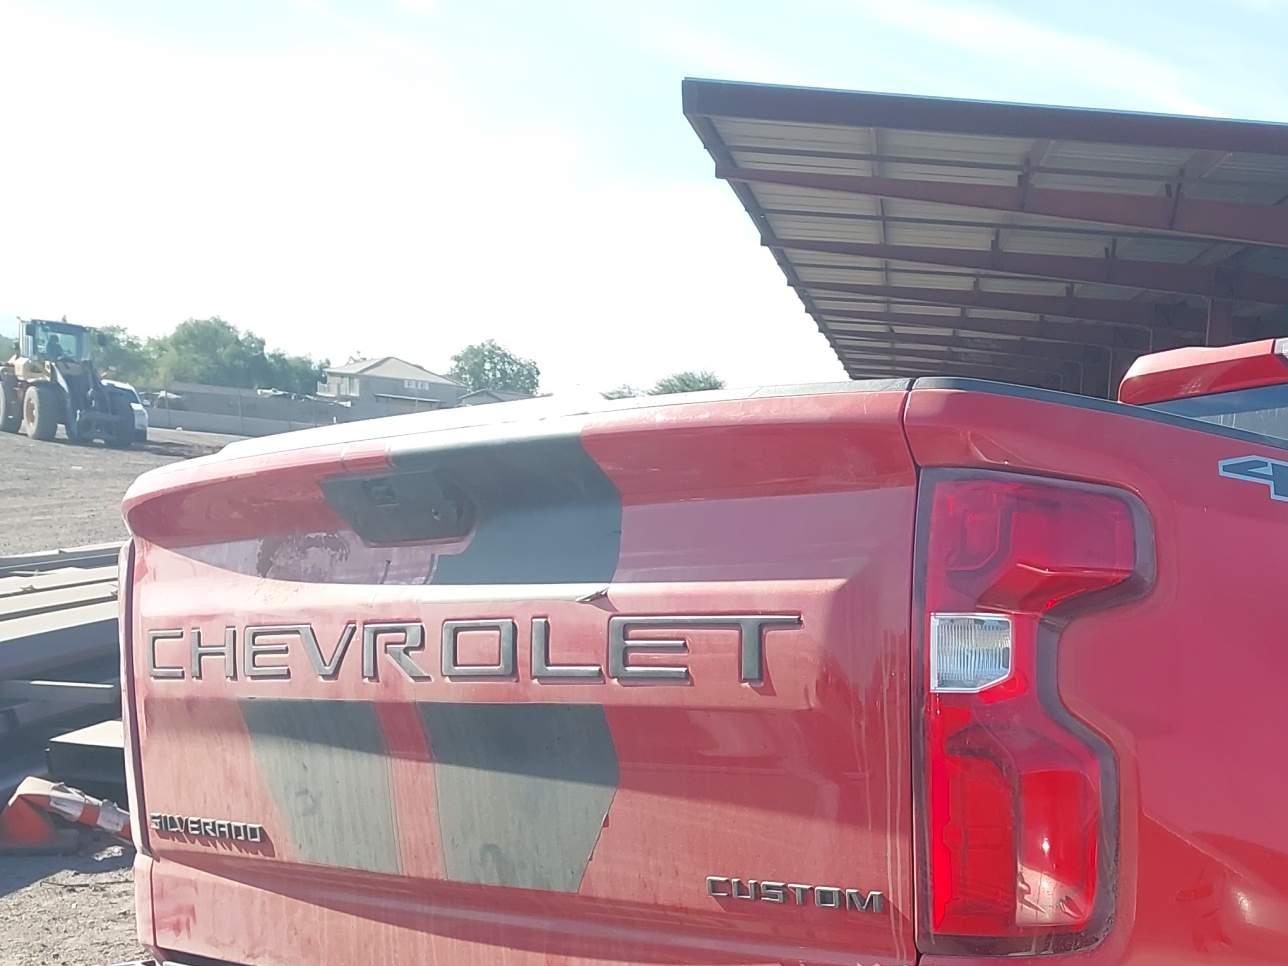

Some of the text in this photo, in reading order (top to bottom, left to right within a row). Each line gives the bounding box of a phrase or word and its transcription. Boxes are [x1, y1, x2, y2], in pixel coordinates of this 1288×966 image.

[148, 614, 801, 685] CHEVROLET
[150, 813, 262, 842] SILVERADO
[706, 876, 883, 912] CUSTOM
